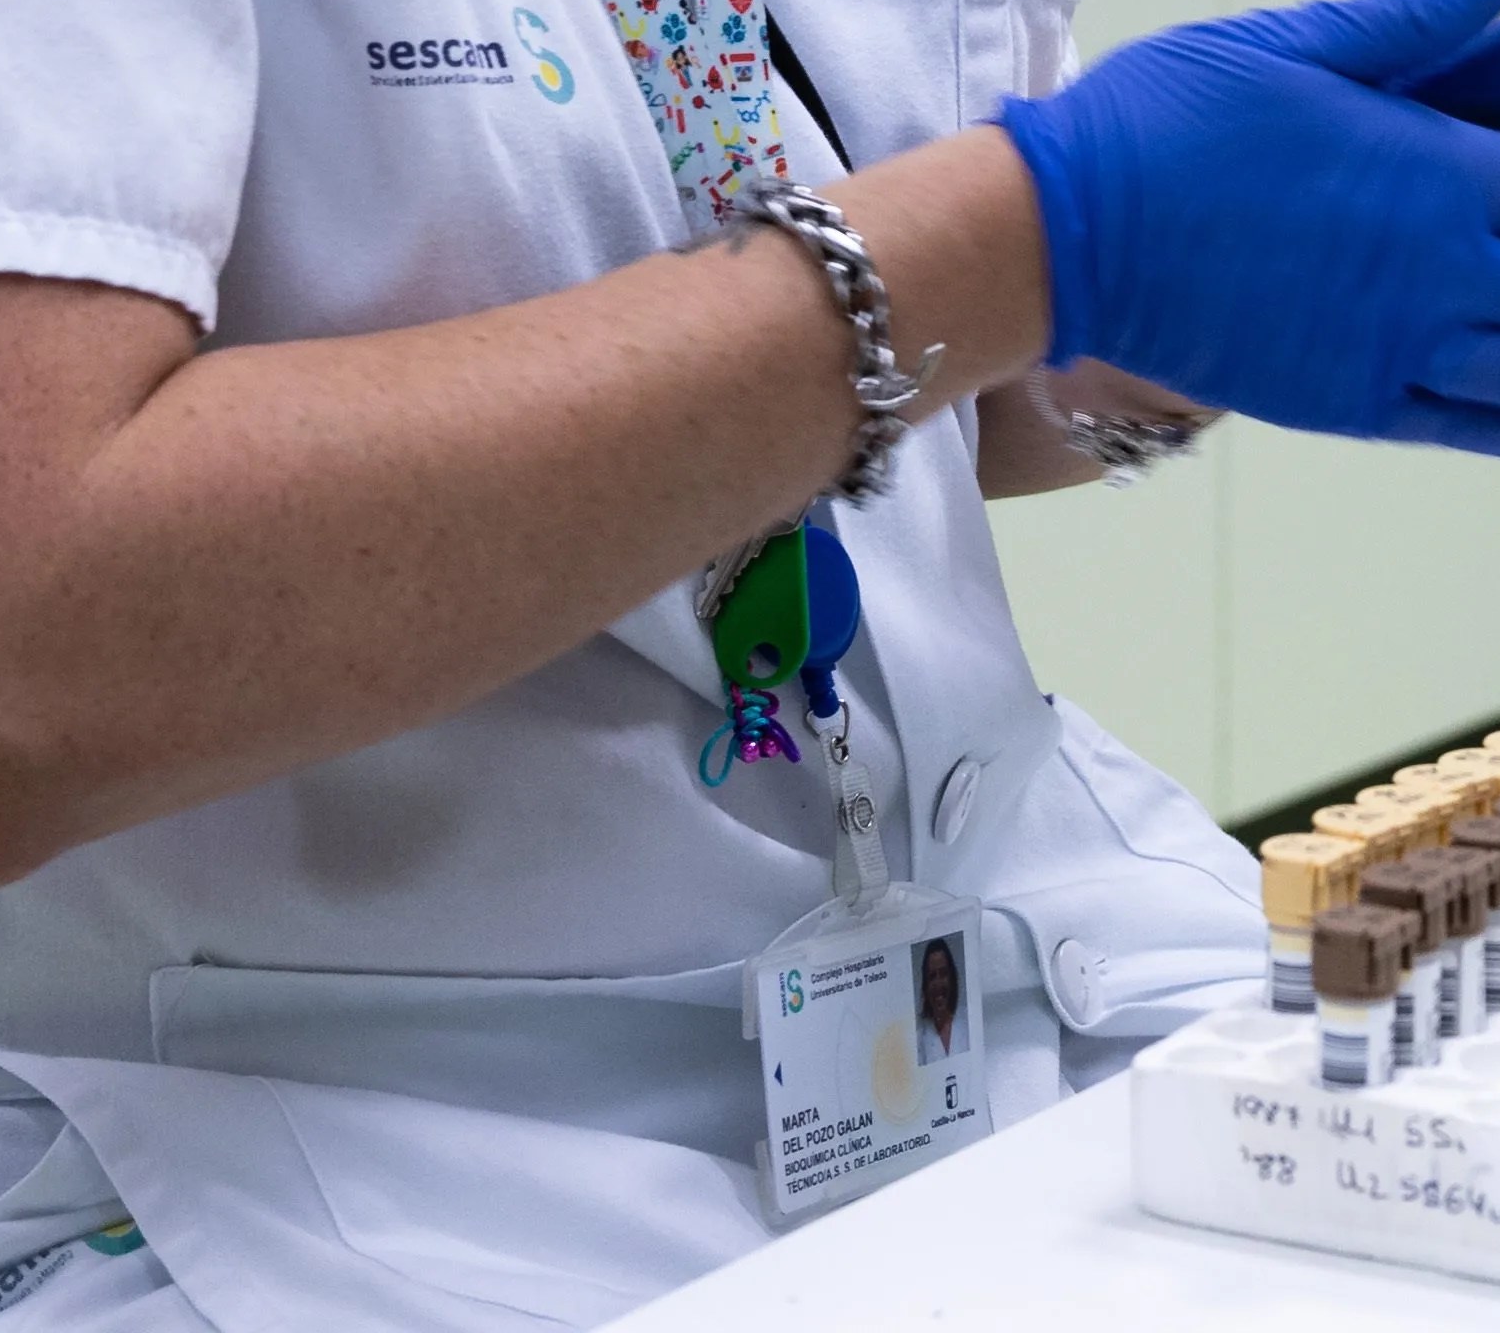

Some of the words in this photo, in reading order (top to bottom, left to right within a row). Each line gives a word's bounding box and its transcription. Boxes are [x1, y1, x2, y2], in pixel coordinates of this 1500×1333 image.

[365, 38, 508, 71] sescam
[782, 1107, 821, 1133] MARTA
[783, 1136, 804, 1156] DEL
[806, 1124, 836, 1149] POZO
[837, 1111, 874, 1137] GALAN
[854, 1156, 867, 1170] DE
